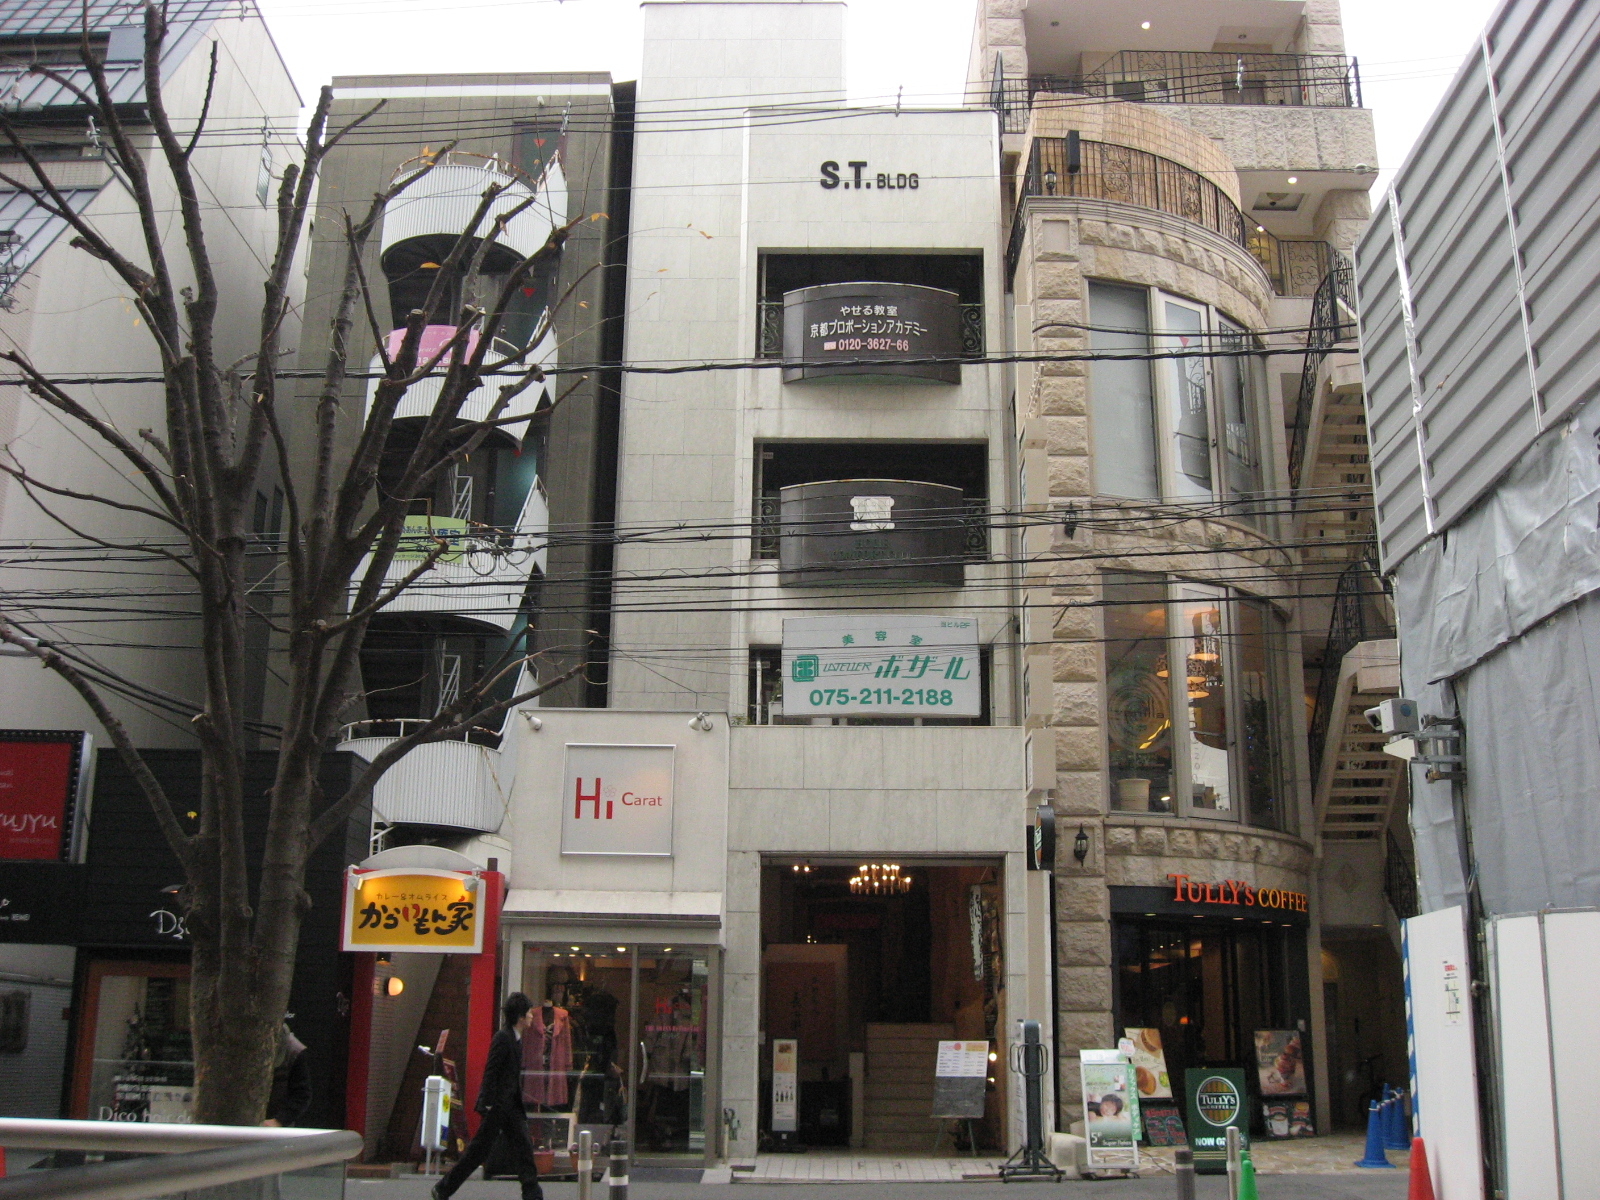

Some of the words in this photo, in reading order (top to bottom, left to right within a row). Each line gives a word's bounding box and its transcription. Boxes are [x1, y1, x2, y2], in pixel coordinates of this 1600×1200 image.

[820, 160, 871, 189] S.T.
[877, 173, 919, 189] BLDG
[840, 305, 898, 317] やせる教室
[810, 319, 928, 338] 京都プロポーションアカデミー
[838, 339, 909, 352] 0120-3627-66
[874, 654, 971, 680] ボザール
[809, 687, 953, 706] 075-211-2188
[575, 777, 613, 819] Hi
[621, 792, 663, 806] Carat
[1258, 887, 1308, 912] COFFEE
[358, 897, 474, 935] からいもん家
[1195, 1137, 1214, 1147] NOW
